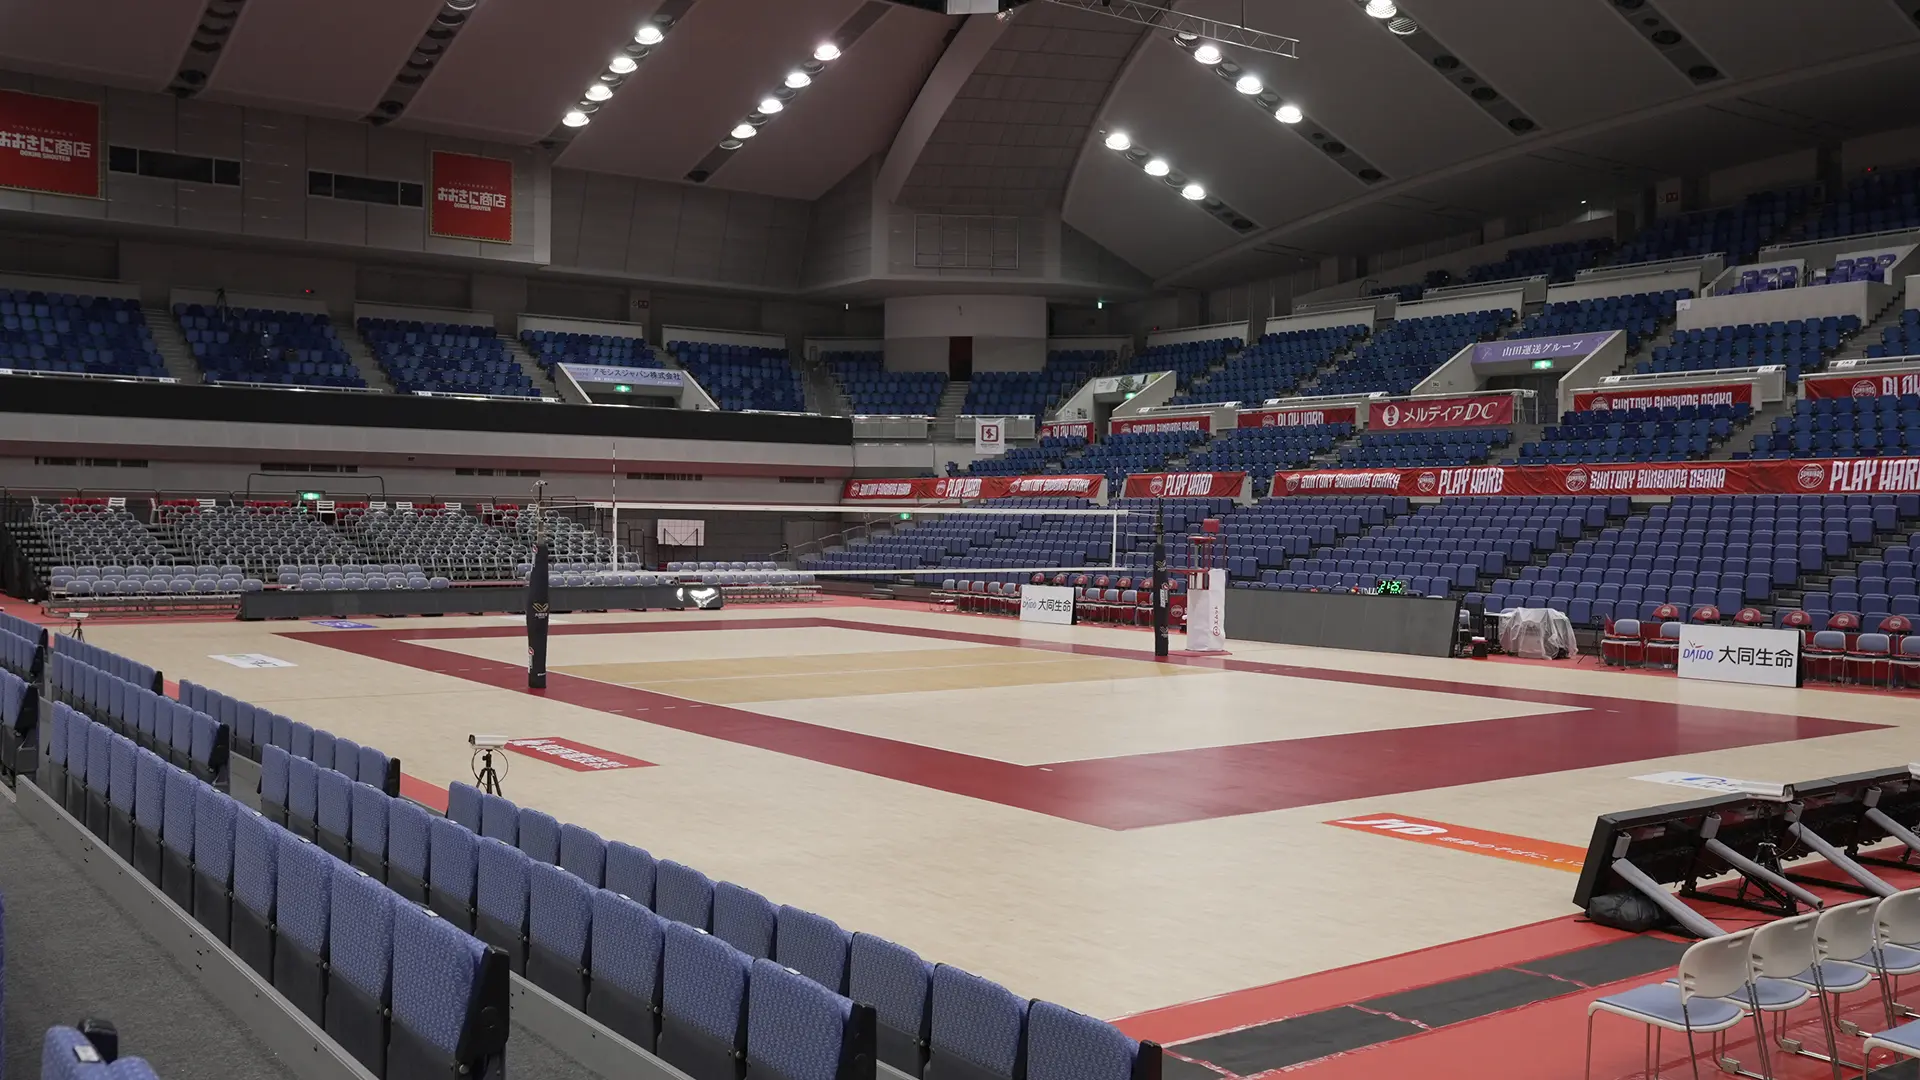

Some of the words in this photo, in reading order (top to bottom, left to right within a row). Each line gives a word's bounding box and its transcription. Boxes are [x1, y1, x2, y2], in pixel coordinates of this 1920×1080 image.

[438, 187, 507, 208] おおきに商店
[1502, 340, 1584, 356] 山田運送グループ
[592, 367, 681, 381] アモシスジャパン株式会社
[1164, 475, 1189, 495] PLAY
[1186, 474, 1213, 495] HARD
[1301, 475, 1336, 488] SUNTORY
[1334, 473, 1372, 488] SUNBIRDS
[1371, 473, 1401, 489] OSAKA
[1438, 469, 1471, 494] PLAY
[1470, 468, 1504, 494] HARD
[1590, 471, 1636, 489] SUNTORY
[1636, 470, 1688, 488] SUNBIRDS
[1688, 469, 1726, 488] OSAKA
[1829, 460, 1878, 490] PLAY
[1878, 459, 1920, 490] HAR
[1038, 598, 1071, 612] 大同生命
[1682, 649, 1714, 662] DAIDO
[1718, 645, 1794, 669] 大同生命
